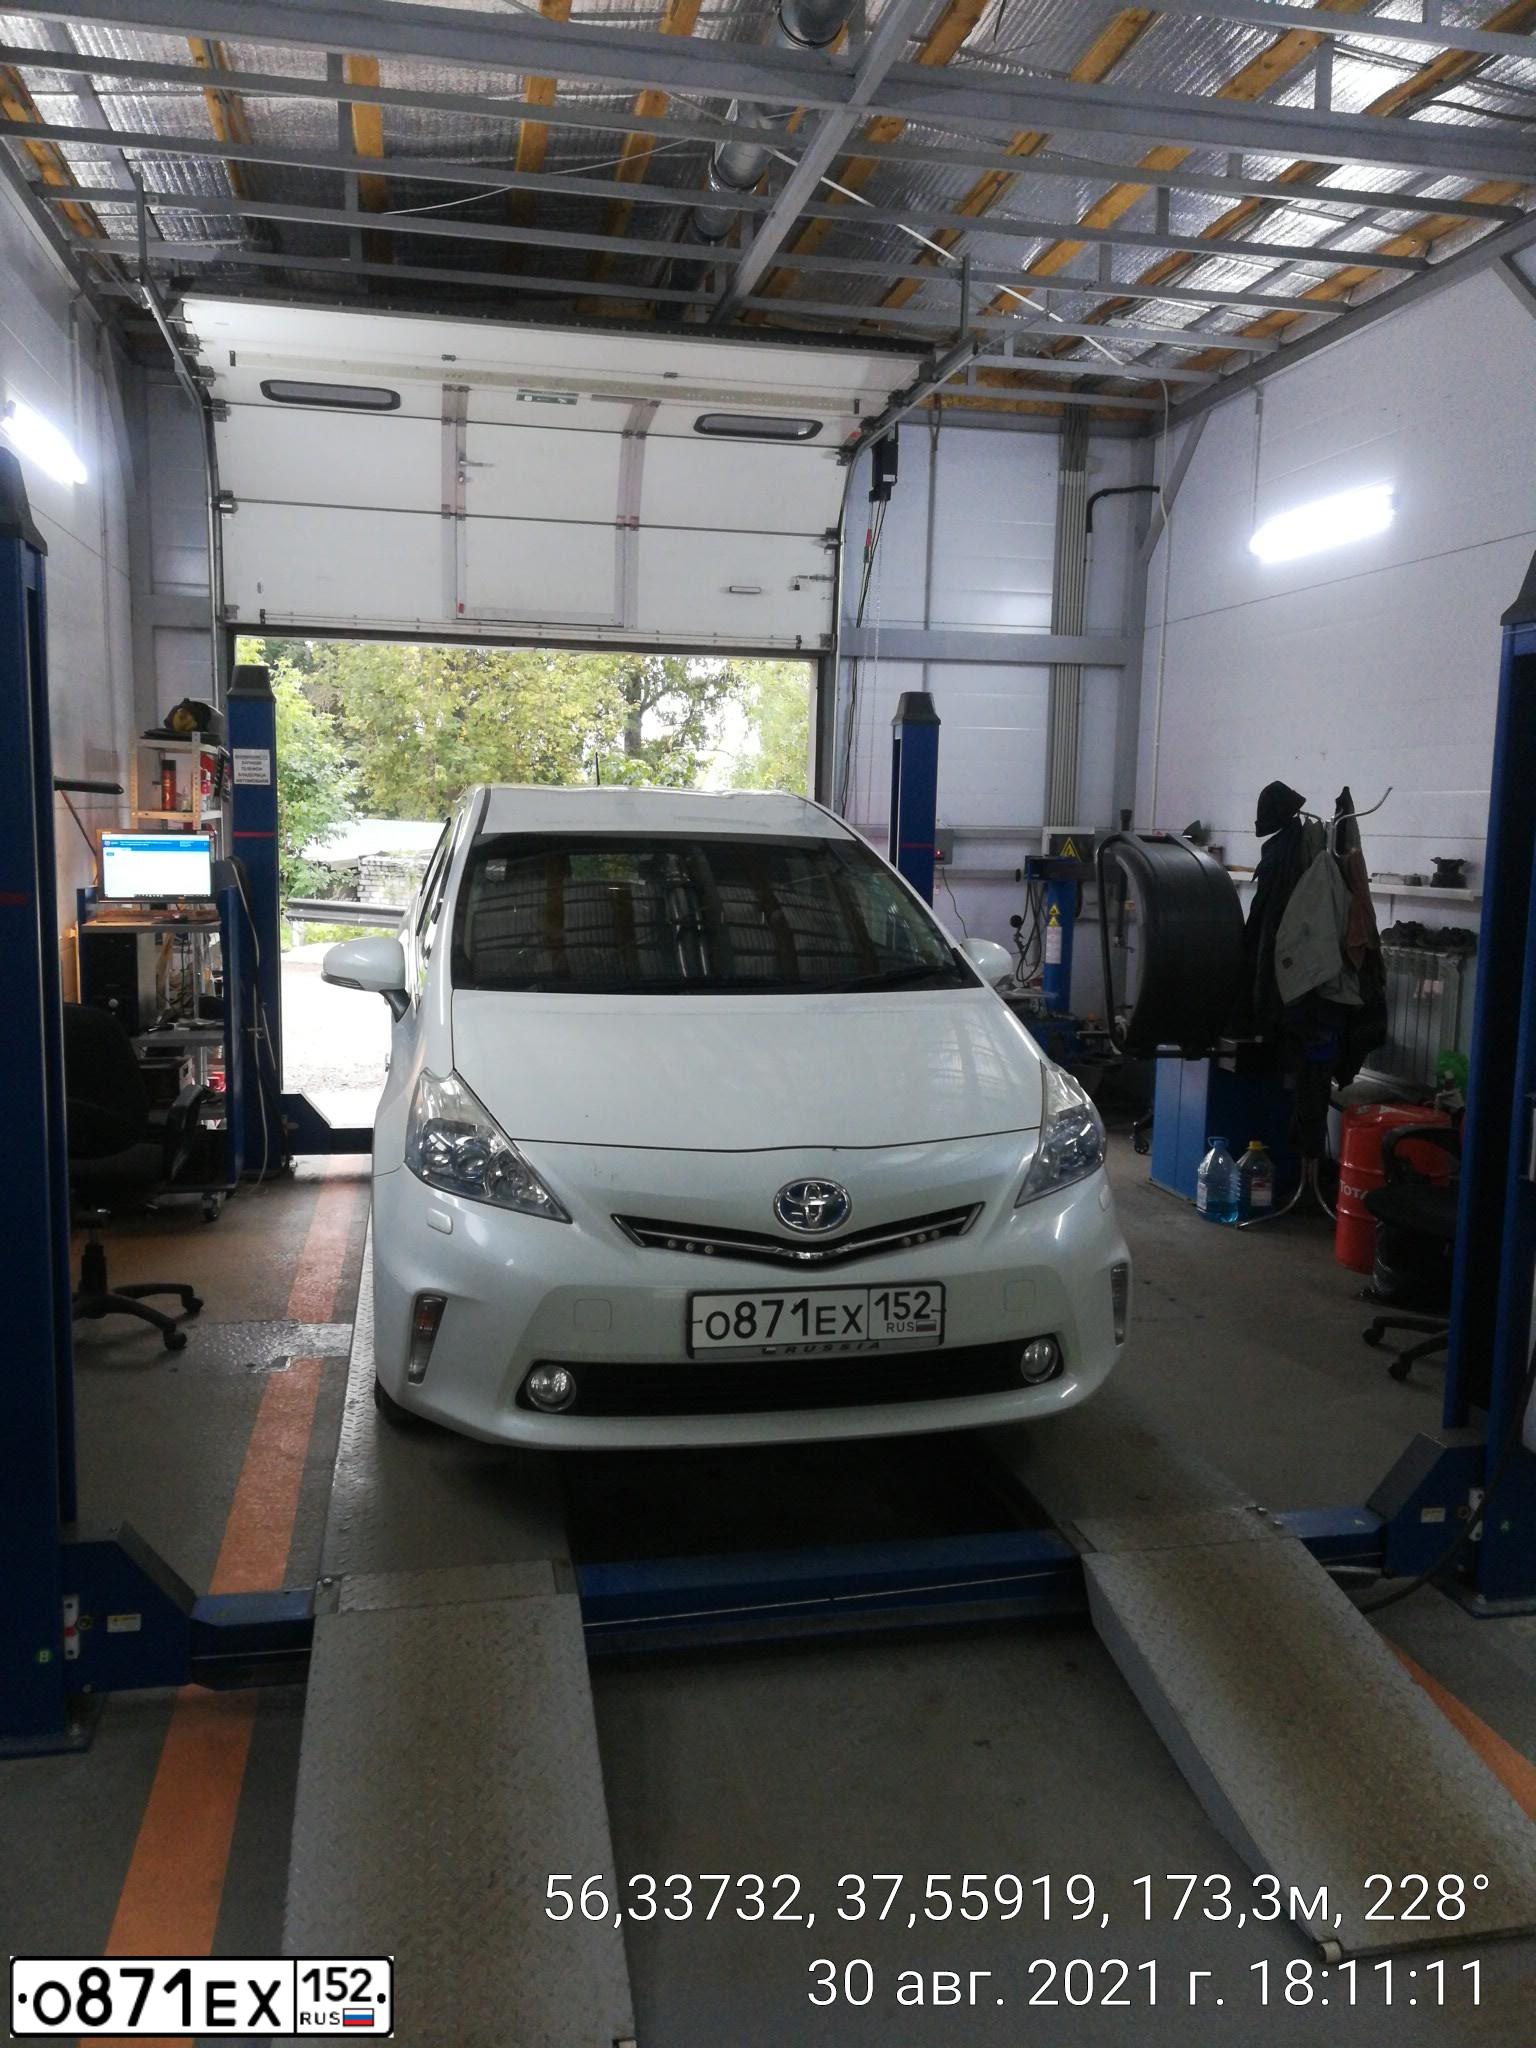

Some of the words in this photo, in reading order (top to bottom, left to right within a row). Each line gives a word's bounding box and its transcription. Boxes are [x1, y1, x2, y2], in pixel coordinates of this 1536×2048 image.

[873, 1290, 931, 1321] 152
[886, 1321, 915, 1334] RUS
[783, 1341, 880, 1355] RUSSIA
